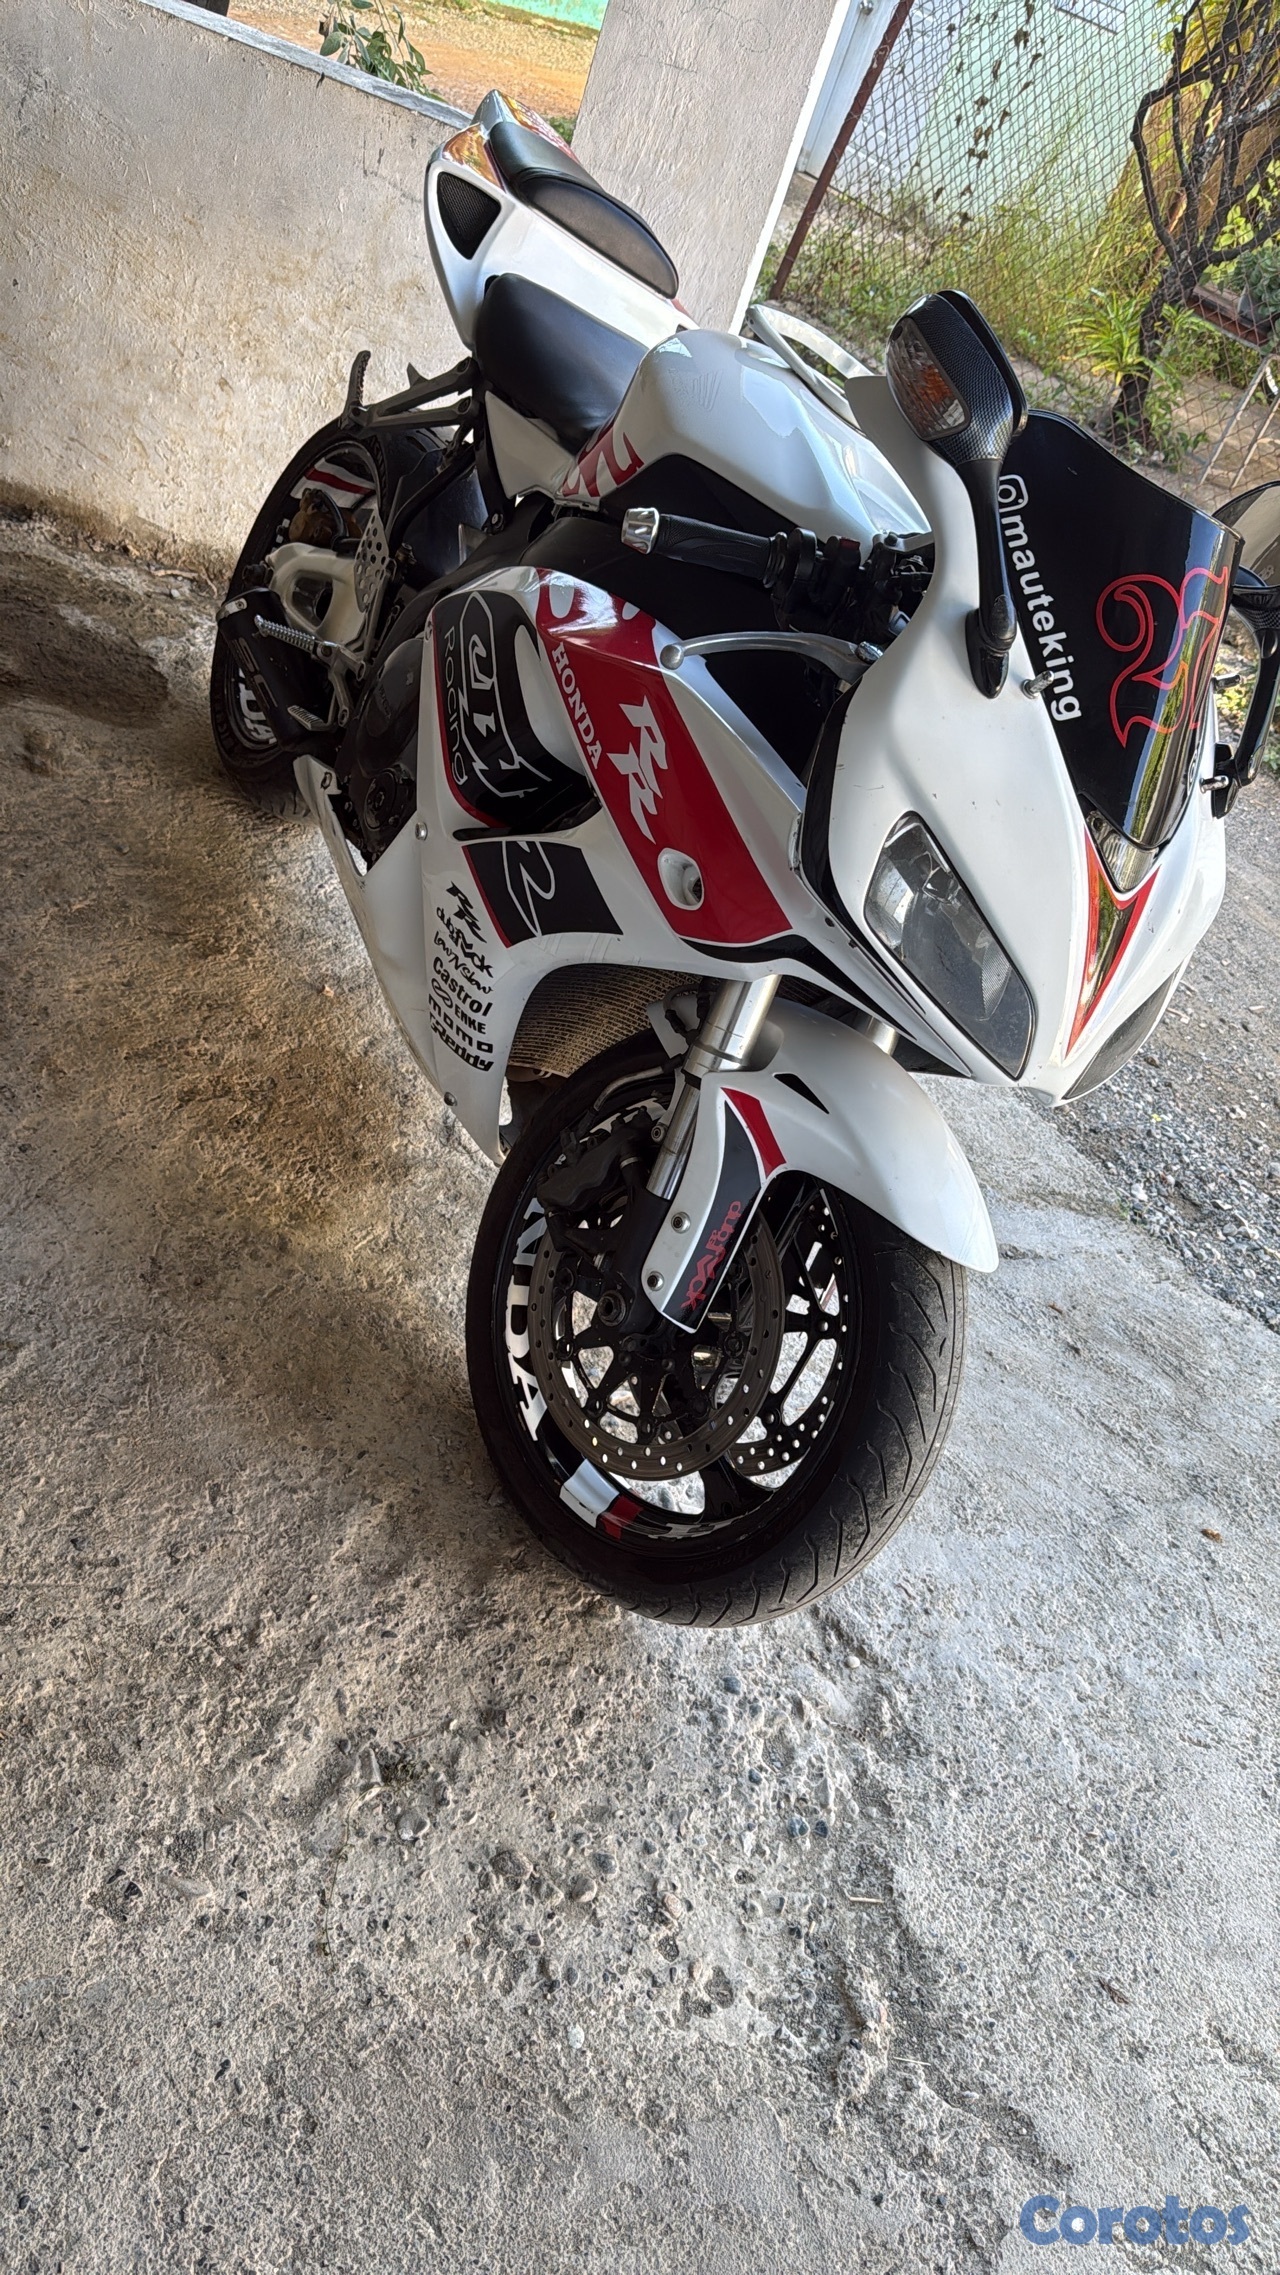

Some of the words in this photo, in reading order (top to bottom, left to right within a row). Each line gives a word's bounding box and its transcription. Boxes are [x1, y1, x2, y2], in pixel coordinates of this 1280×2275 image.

[1000, 513, 1082, 721] mauteking
[443, 626, 468, 785] Racing
[551, 642, 603, 769] HONDA
[607, 695, 668, 844] RR
[446, 881, 487, 943] RR
[429, 993, 493, 1053] momo
[433, 956, 493, 1016] Castrol
[505, 1197, 548, 1443] NDA
